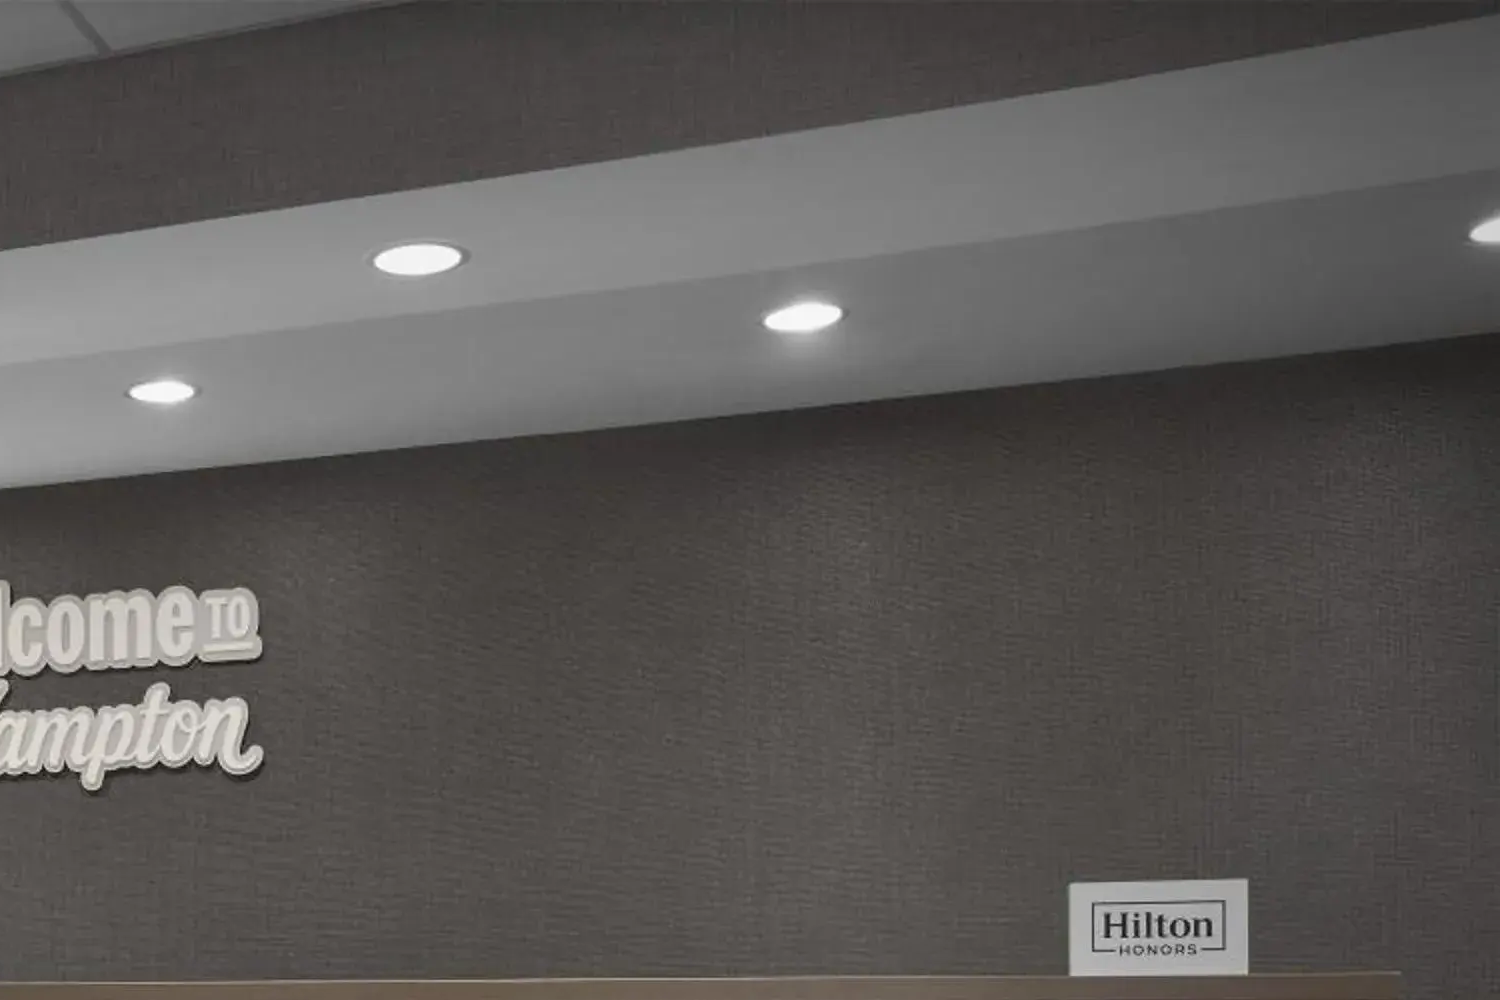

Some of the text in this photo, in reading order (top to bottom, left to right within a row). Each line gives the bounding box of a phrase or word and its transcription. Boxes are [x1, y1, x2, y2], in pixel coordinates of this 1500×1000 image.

[204, 595, 255, 651] TO
[1103, 911, 1213, 939] Hilton
[1119, 943, 1198, 957] HONORS
